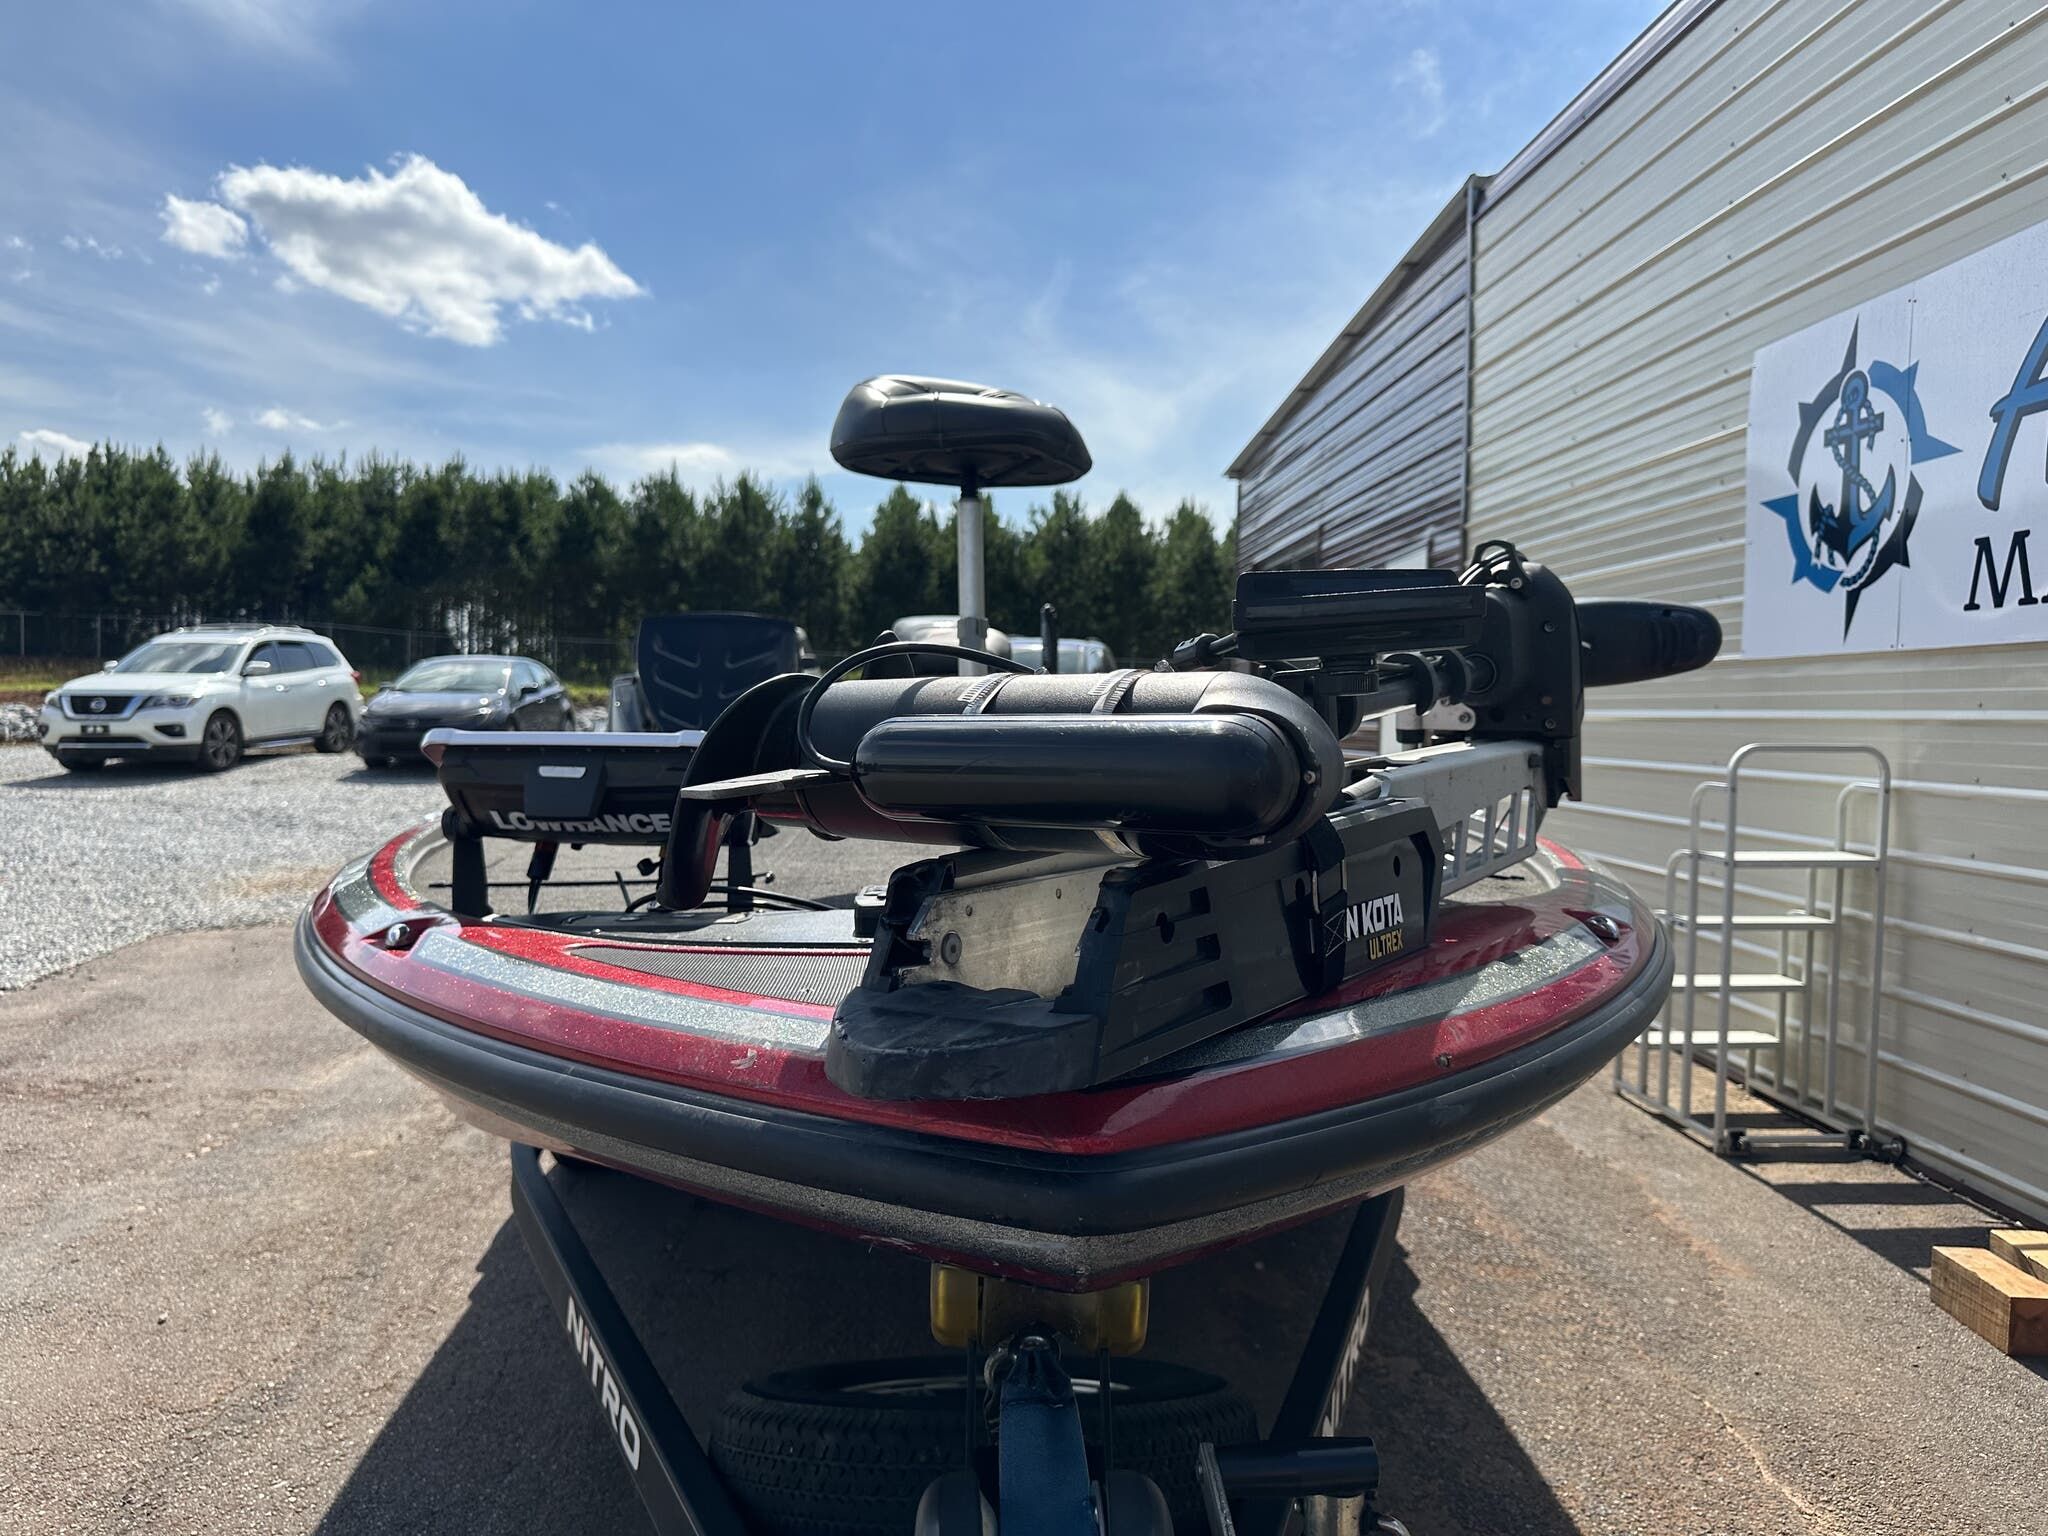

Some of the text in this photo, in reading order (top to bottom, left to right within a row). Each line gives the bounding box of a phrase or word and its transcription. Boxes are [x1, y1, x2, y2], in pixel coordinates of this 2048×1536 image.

[1963, 529, 2048, 611] M
[1361, 893, 1404, 936] KOTA
[1369, 929, 1404, 960] ULTREX
[567, 1296, 641, 1471] NITRO
